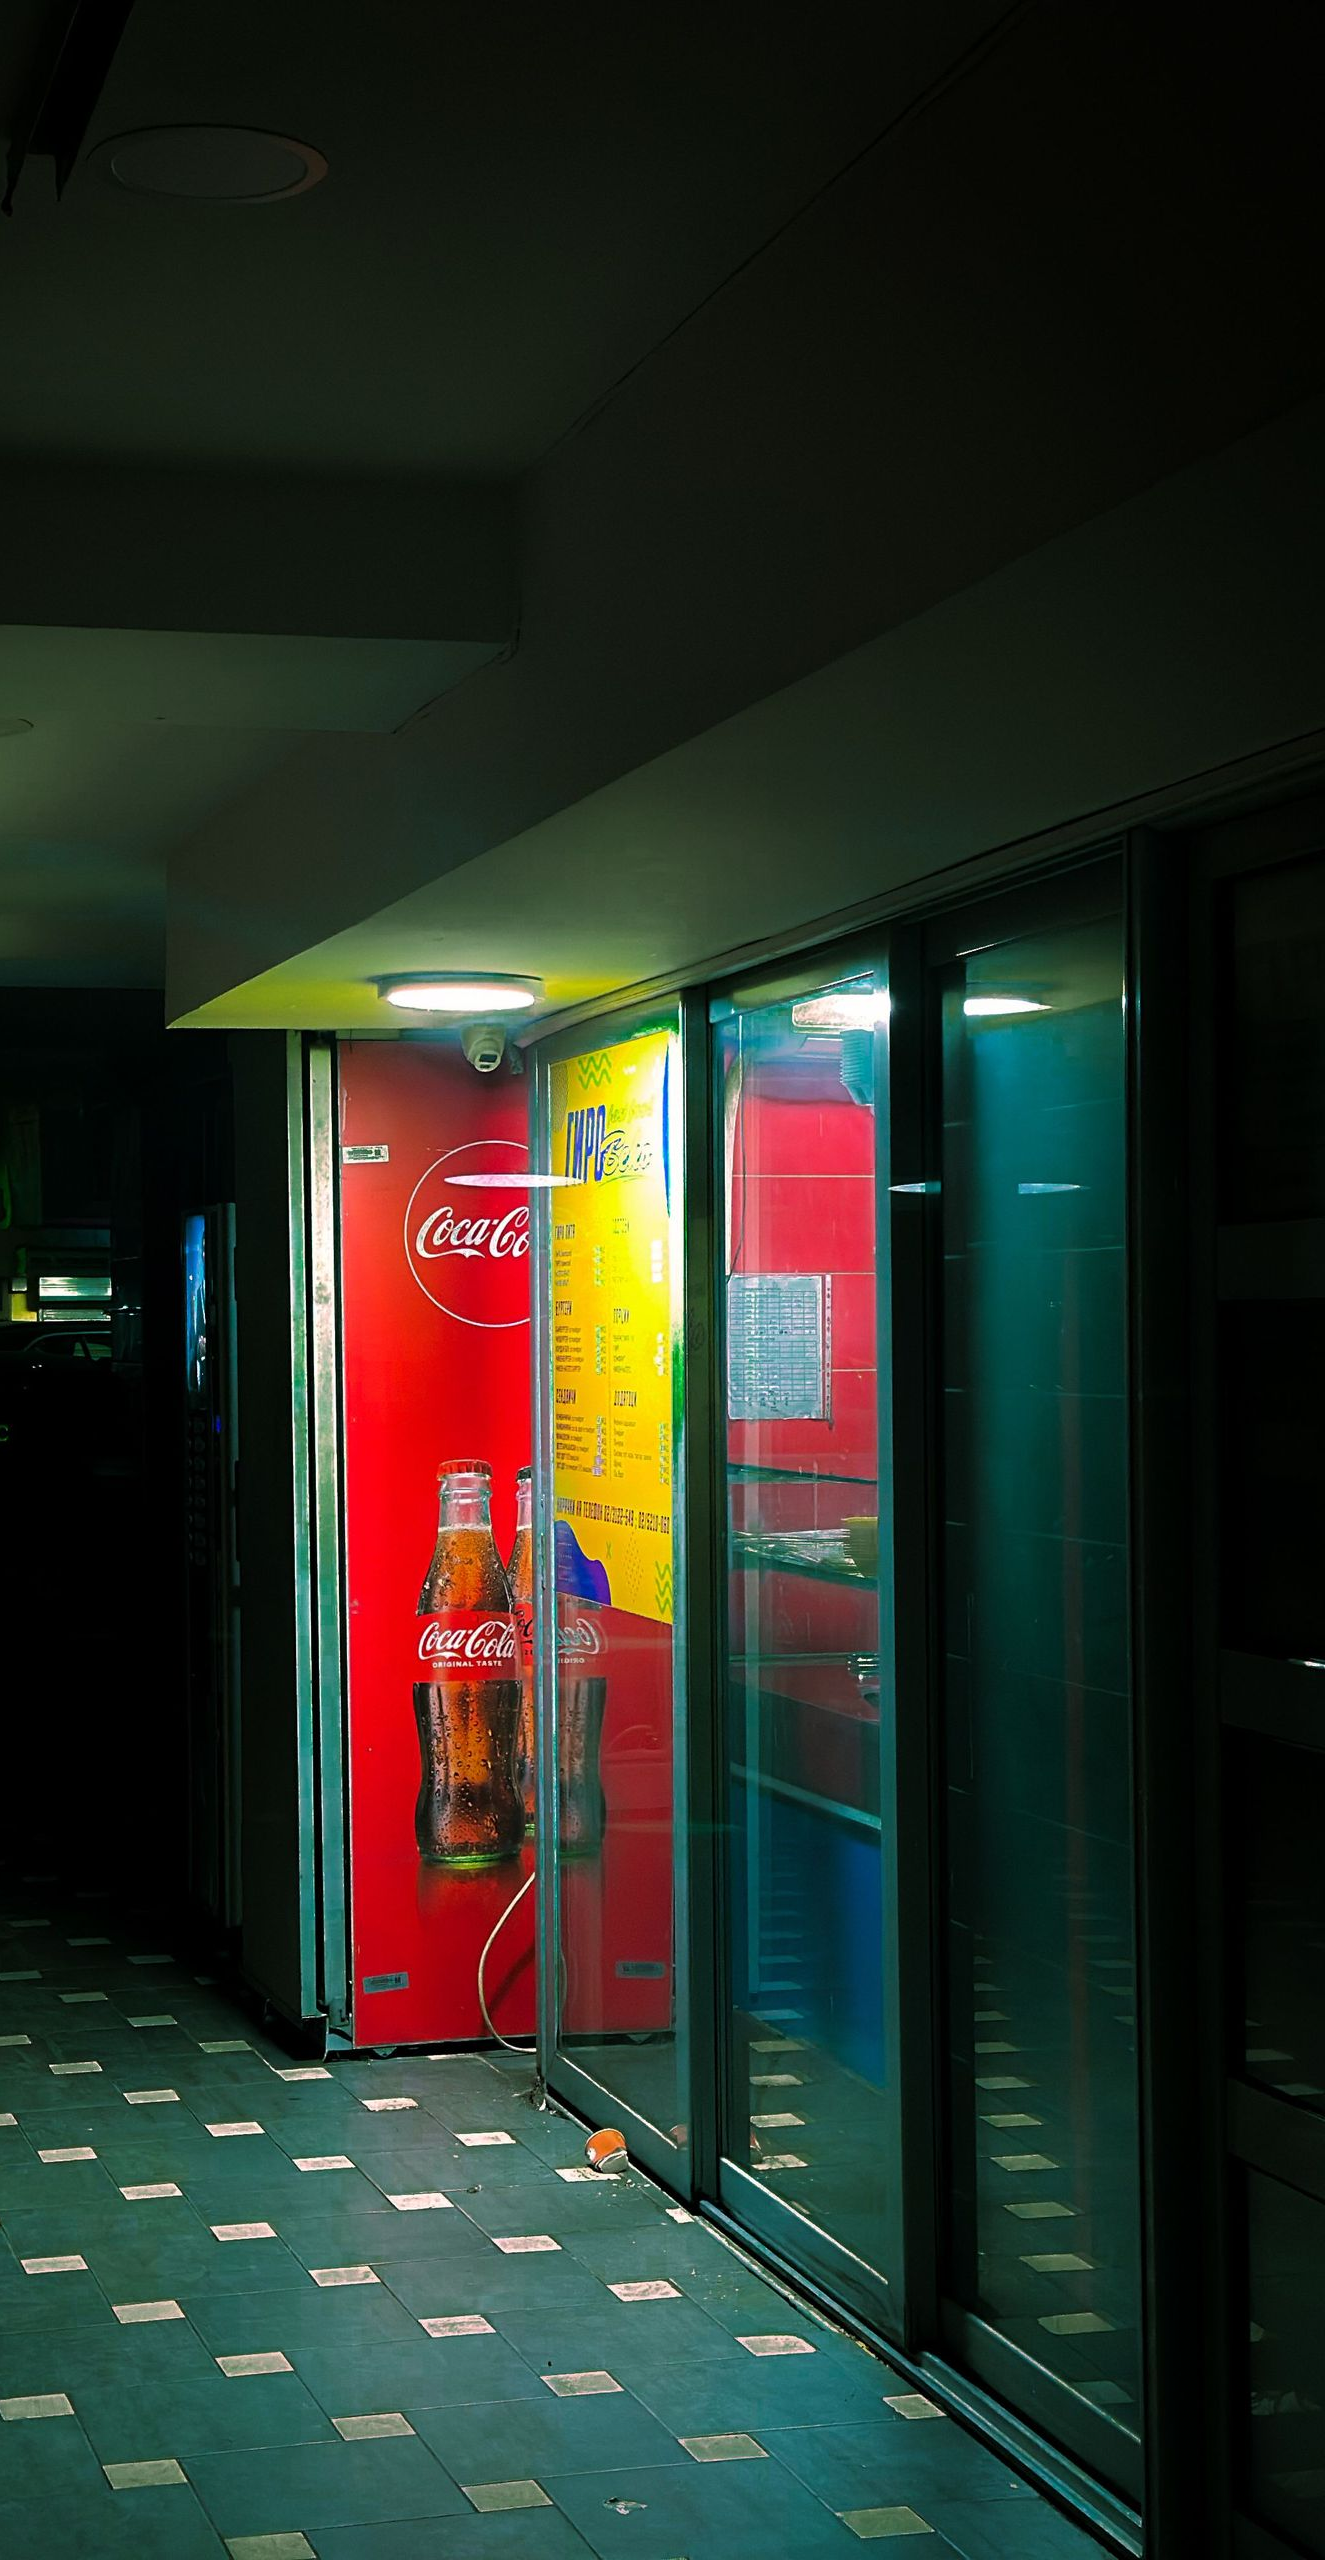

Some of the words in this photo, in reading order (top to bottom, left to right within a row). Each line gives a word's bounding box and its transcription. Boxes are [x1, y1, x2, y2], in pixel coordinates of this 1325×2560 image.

[565, 1105, 606, 1187] ГИРО
[418, 1620, 516, 1661] Coca-Cola
[432, 1660, 474, 1669] ORIGINAL
[476, 1659, 503, 1667] TASTE
